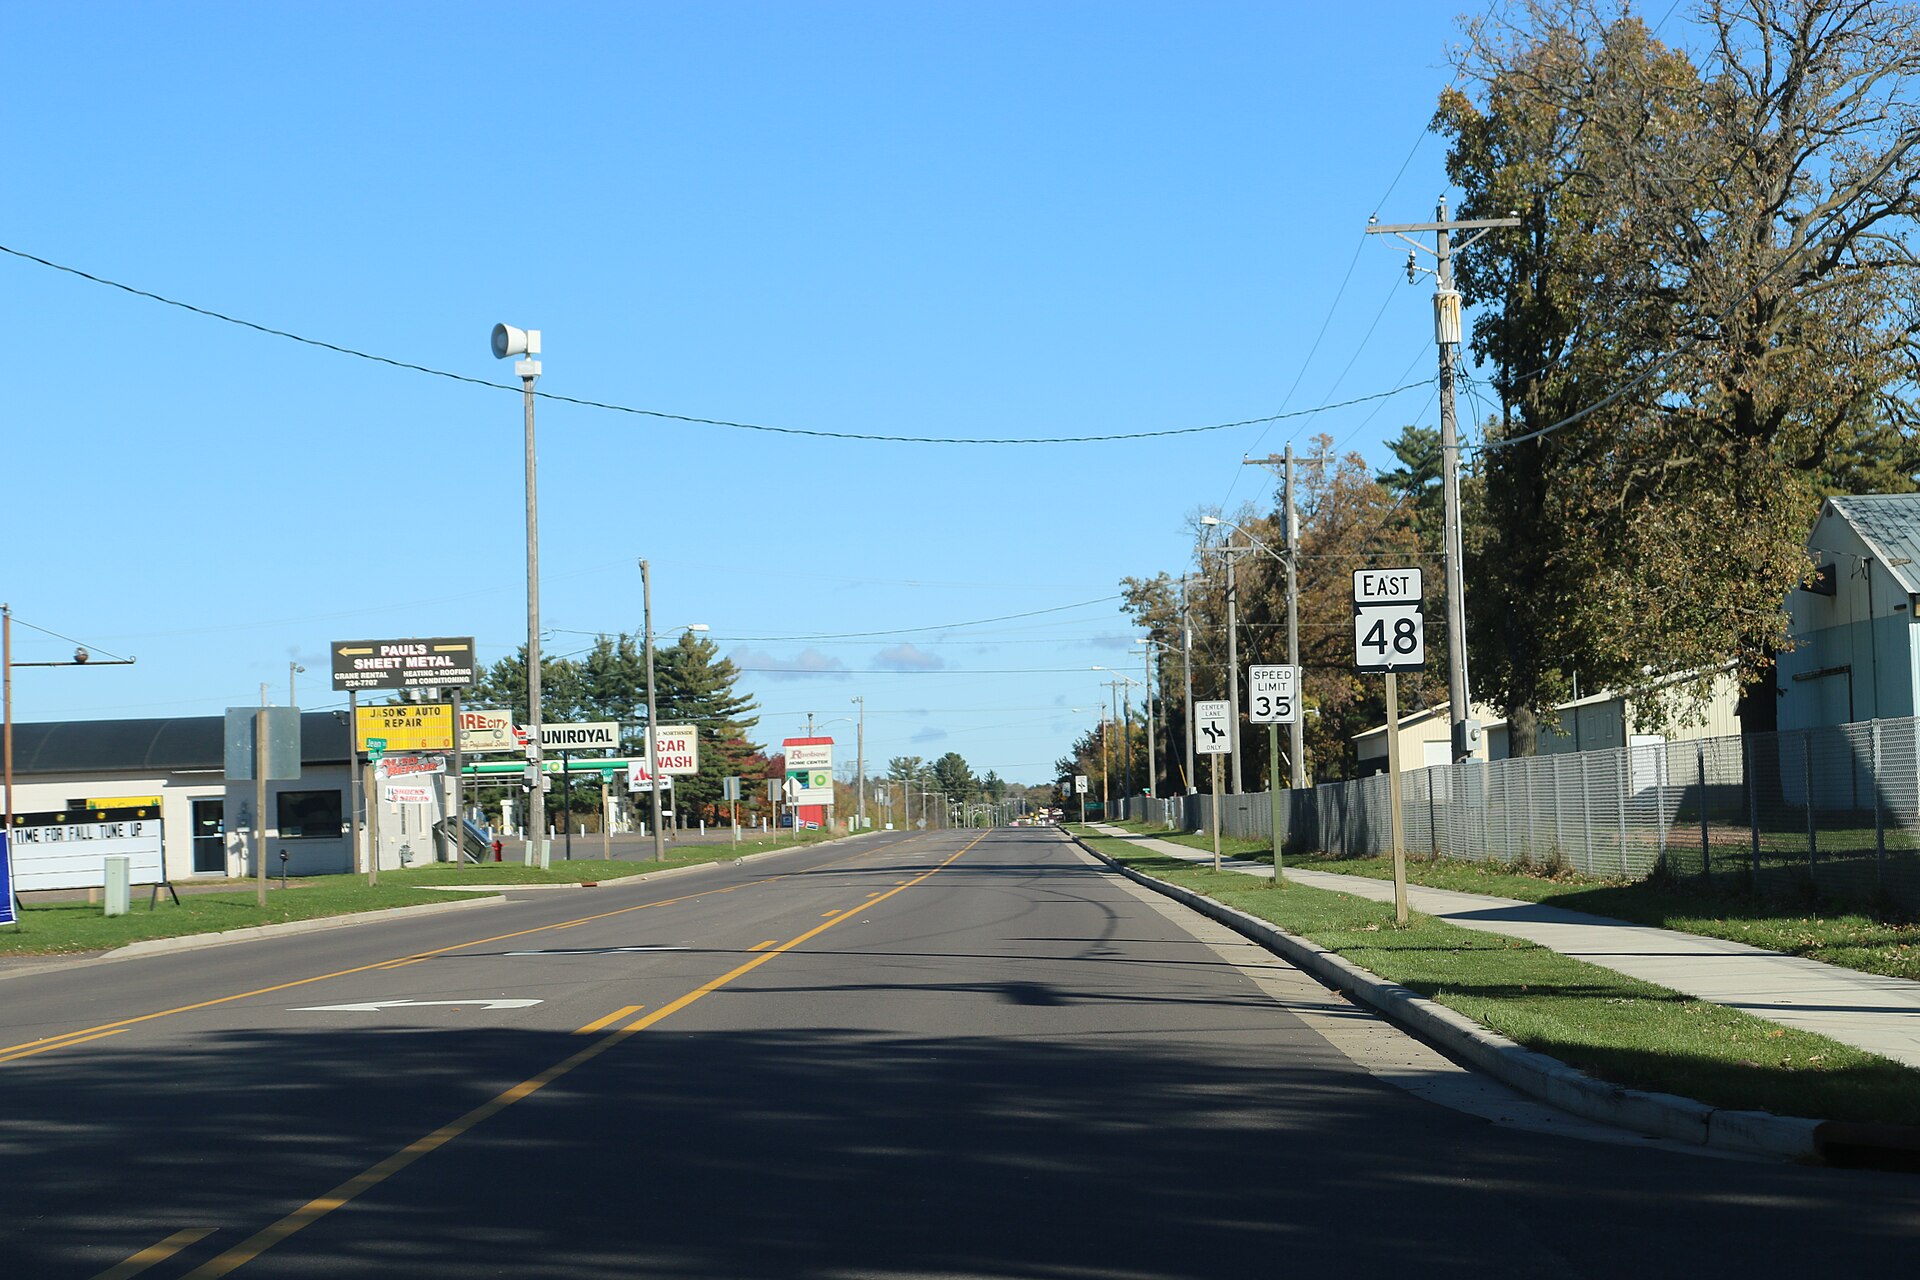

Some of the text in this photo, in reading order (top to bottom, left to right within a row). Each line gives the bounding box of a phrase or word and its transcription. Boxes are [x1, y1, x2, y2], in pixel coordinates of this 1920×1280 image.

[1363, 575, 1410, 596] EAST
[1361, 618, 1417, 655] 48
[380, 644, 427, 656] PAUL'S
[354, 656, 455, 670] SHEET METAL
[334, 671, 389, 680] CRANE RENTAL
[402, 668, 472, 678] HEATING ROOFING
[1253, 670, 1292, 680] SPEED
[404, 675, 470, 686] AIR CONDITIONING
[1257, 682, 1288, 692] LIMIT
[414, 706, 441, 717] AUTO
[1255, 696, 1292, 717] 35
[384, 718, 422, 729] REPAIR
[460, 713, 509, 730] IRE CITY
[541, 728, 613, 744] UNIROYAL
[367, 738, 382, 748] Jean
[656, 740, 686, 752] CAR
[387, 763, 438, 777] REPAIR
[14, 822, 143, 843] TIME FOR FALL TUNE UP
